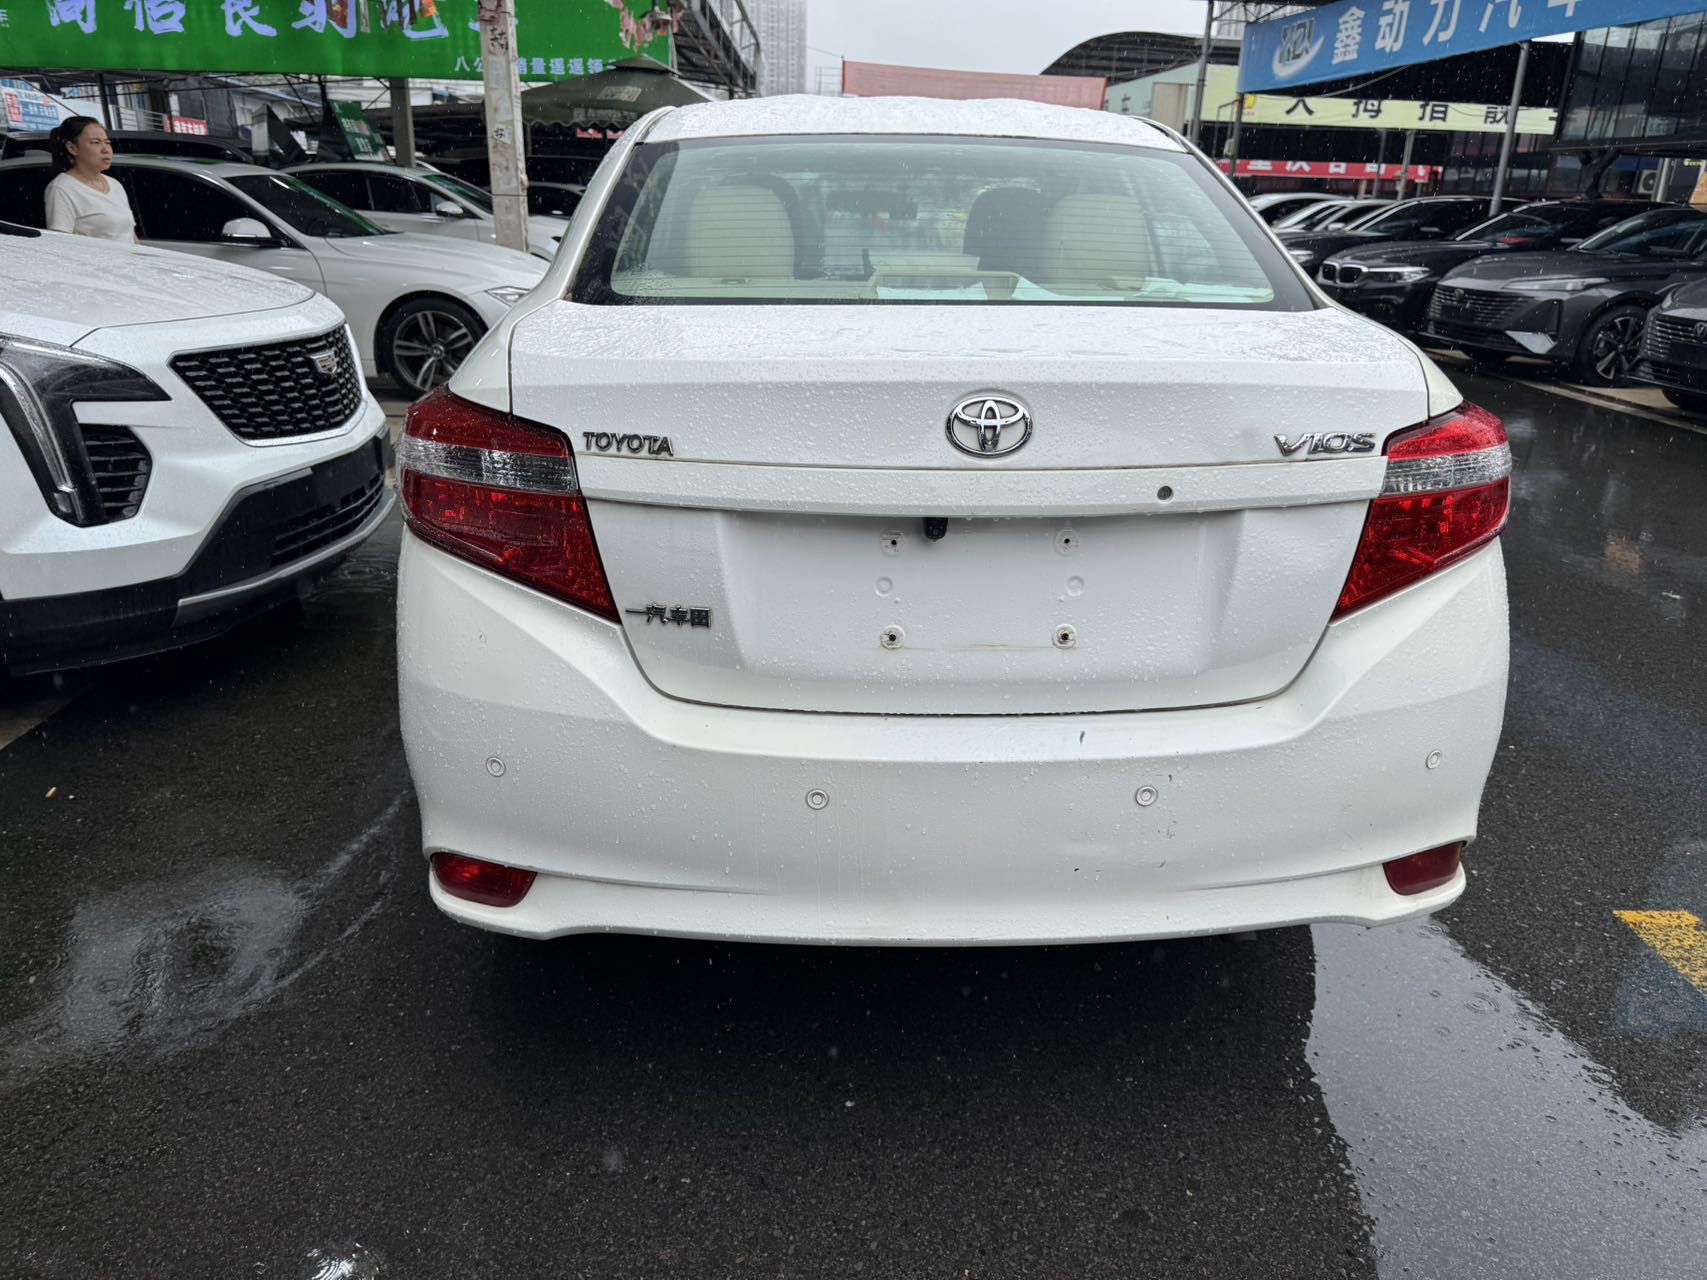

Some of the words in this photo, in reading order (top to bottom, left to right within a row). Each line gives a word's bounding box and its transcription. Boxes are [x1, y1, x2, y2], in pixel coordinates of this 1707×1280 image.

[454, 56, 617, 76] 八公销量遥遥领
[583, 431, 674, 457] TOYOTA
[1274, 432, 1376, 457] VIOS
